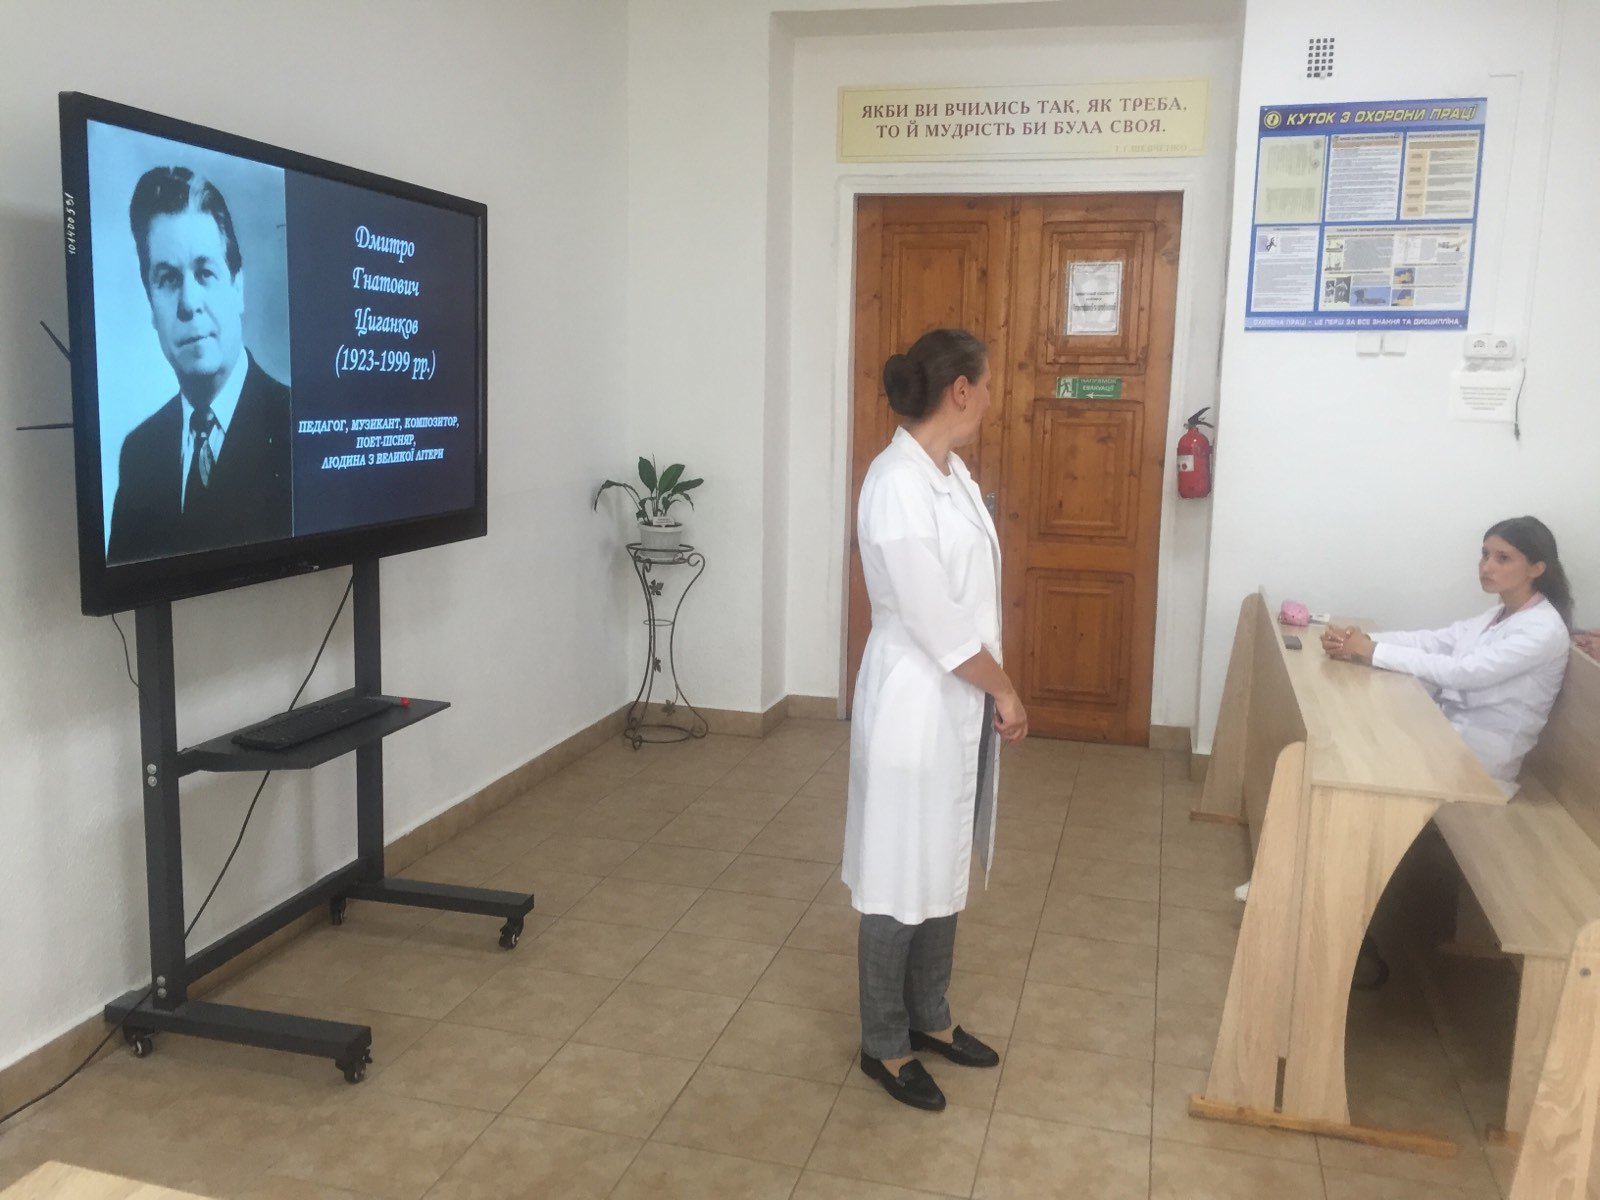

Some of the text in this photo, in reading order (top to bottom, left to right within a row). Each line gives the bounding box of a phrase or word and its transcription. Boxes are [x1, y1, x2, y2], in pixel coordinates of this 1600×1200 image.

[861, 104, 909, 119] ЯКБИ
[915, 103, 938, 118] ВИ
[944, 101, 1031, 117] ВЧИЛИСЬ
[1037, 99, 1080, 115] ТАК,
[1087, 98, 1112, 113] ЯК
[1286, 104, 1478, 126] КУТОК З ОХОРОНИ ПРАЦІ
[876, 118, 1167, 139] ТО Й МУДРІСТЬ БИ БУЛА СВОЯ.
[355, 225, 415, 263] Дмитро
[352, 266, 420, 297] Гнатович
[354, 307, 419, 340] Циганков
[1402, 318, 1412, 326] ТА
[335, 344, 436, 381] (1923-1999 рр.)
[298, 416, 460, 435] ПЕДАГОГ, МУЗИКАНТ, КОМПОЗИТОР,
[356, 434, 417, 449] ПОЕТ-ПІСНЯР,
[321, 448, 445, 470] ЛЮДИНА З ВЕЛИКОЇ ЛІТЕРИ
